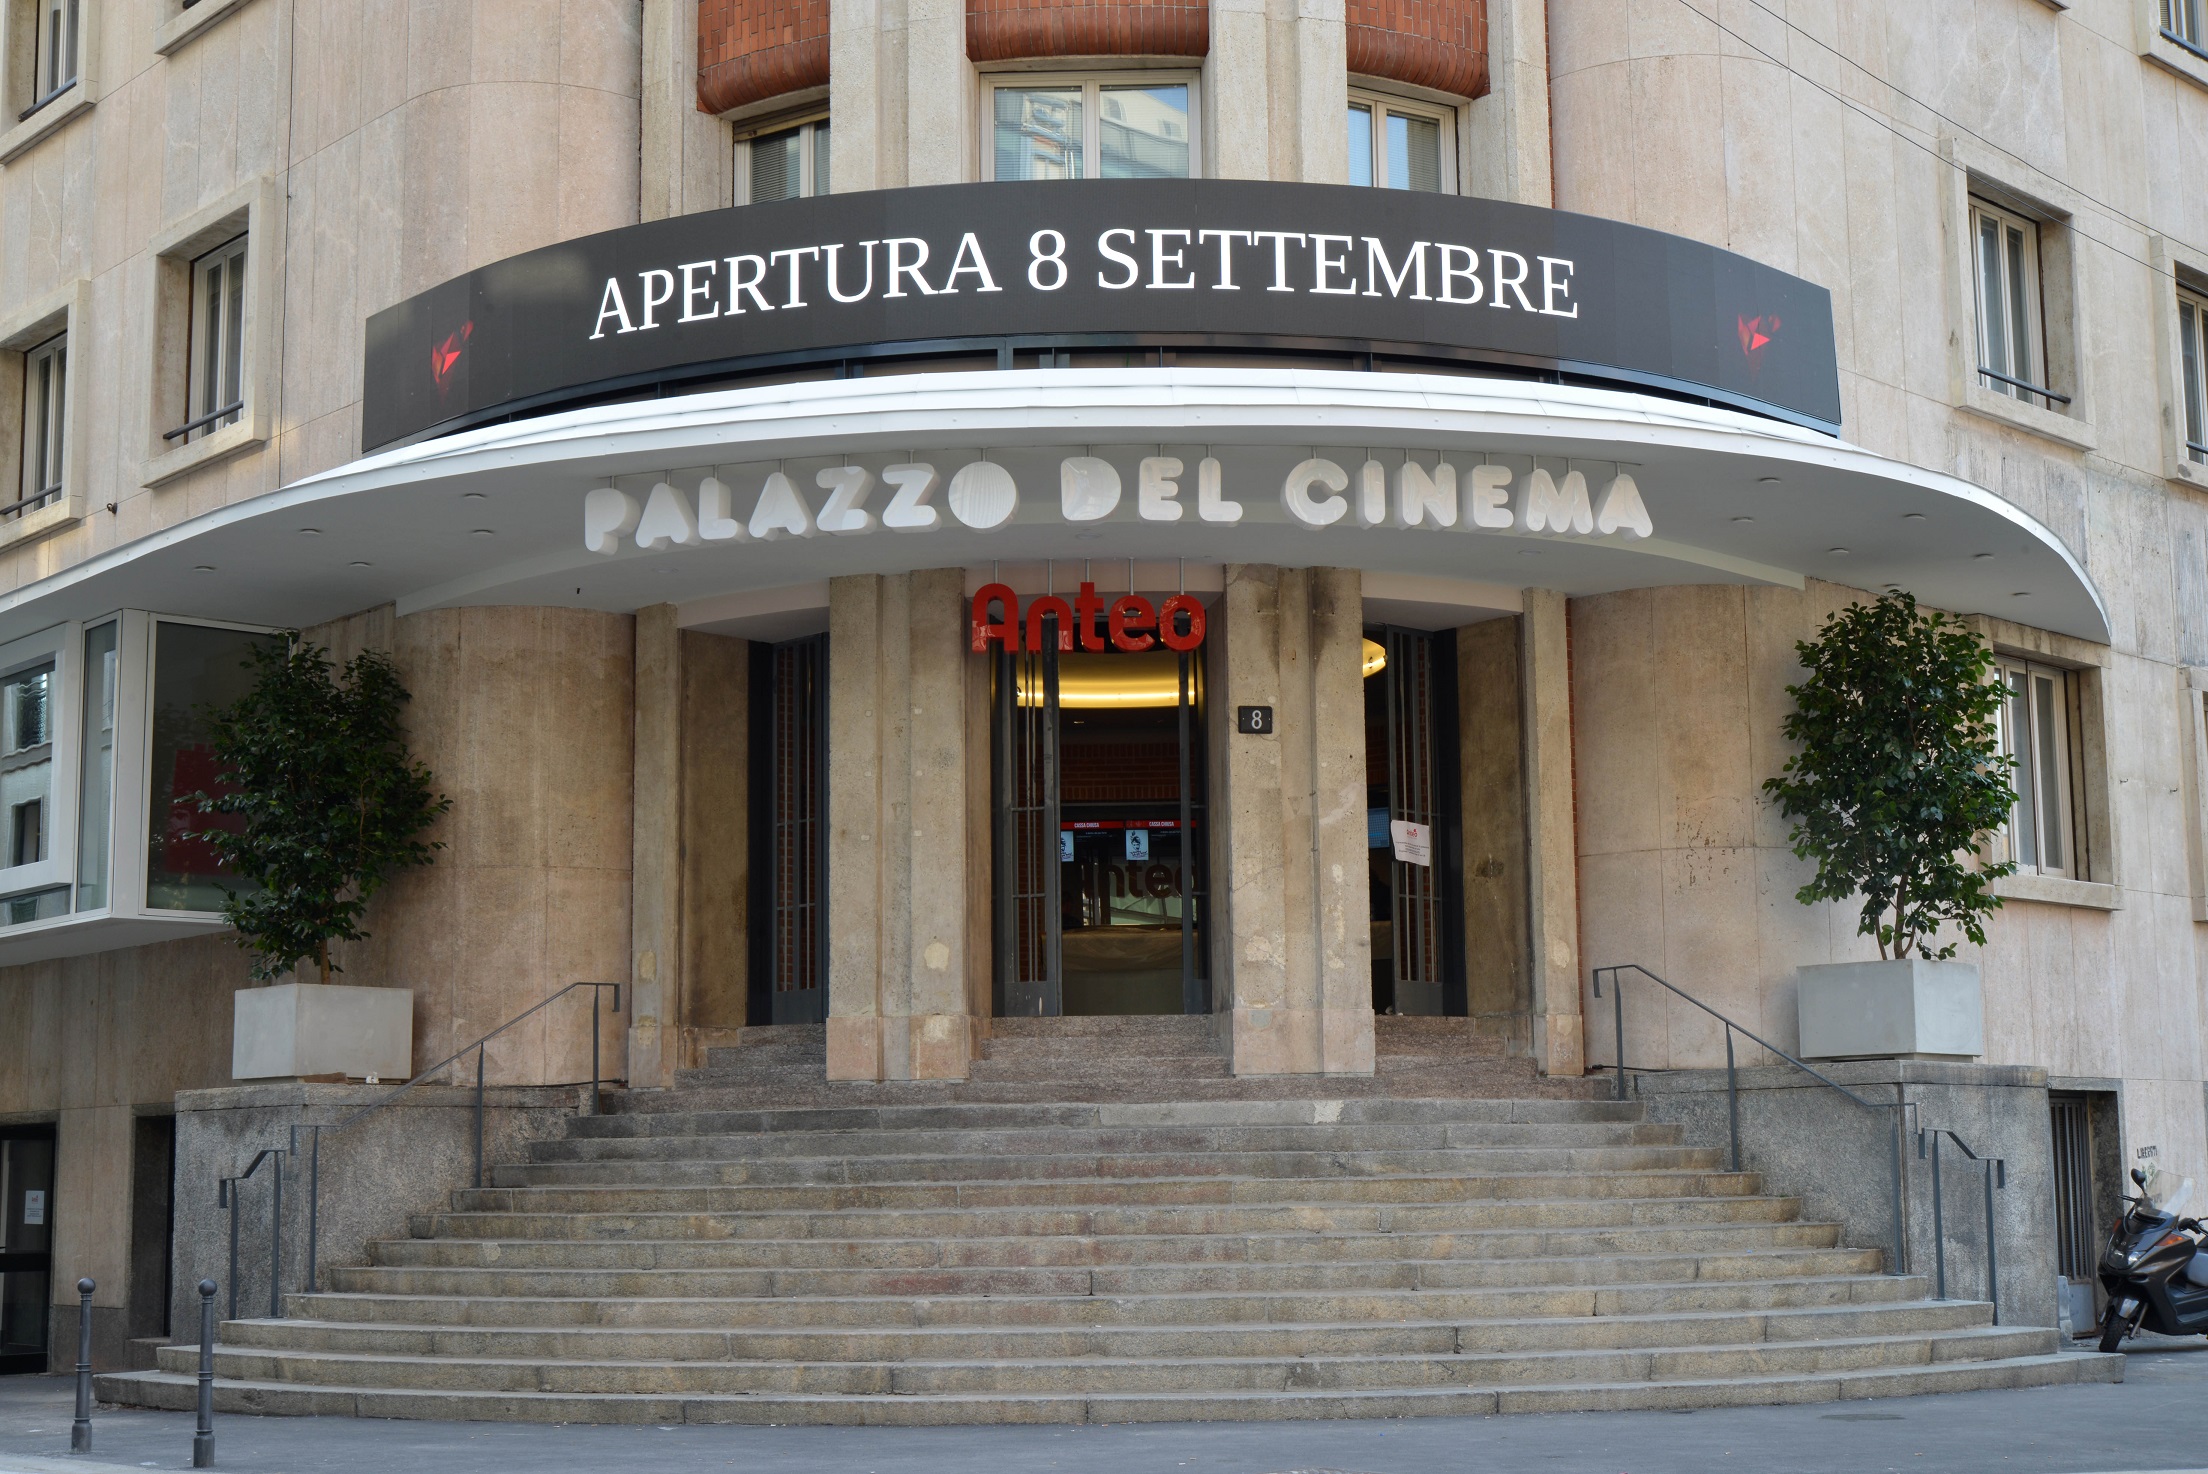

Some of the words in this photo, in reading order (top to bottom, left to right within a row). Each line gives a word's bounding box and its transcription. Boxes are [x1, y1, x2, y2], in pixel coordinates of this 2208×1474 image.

[588, 231, 1003, 340] APERTURA
[1027, 229, 1068, 291] 8
[1097, 228, 1579, 319] SETTEMBRE
[585, 461, 1020, 555] PALAZZO
[1060, 456, 1244, 528] DEL
[1281, 458, 1654, 541] CINEMA
[972, 582, 1206, 653] Anteo
[1251, 710, 1262, 730] 8
